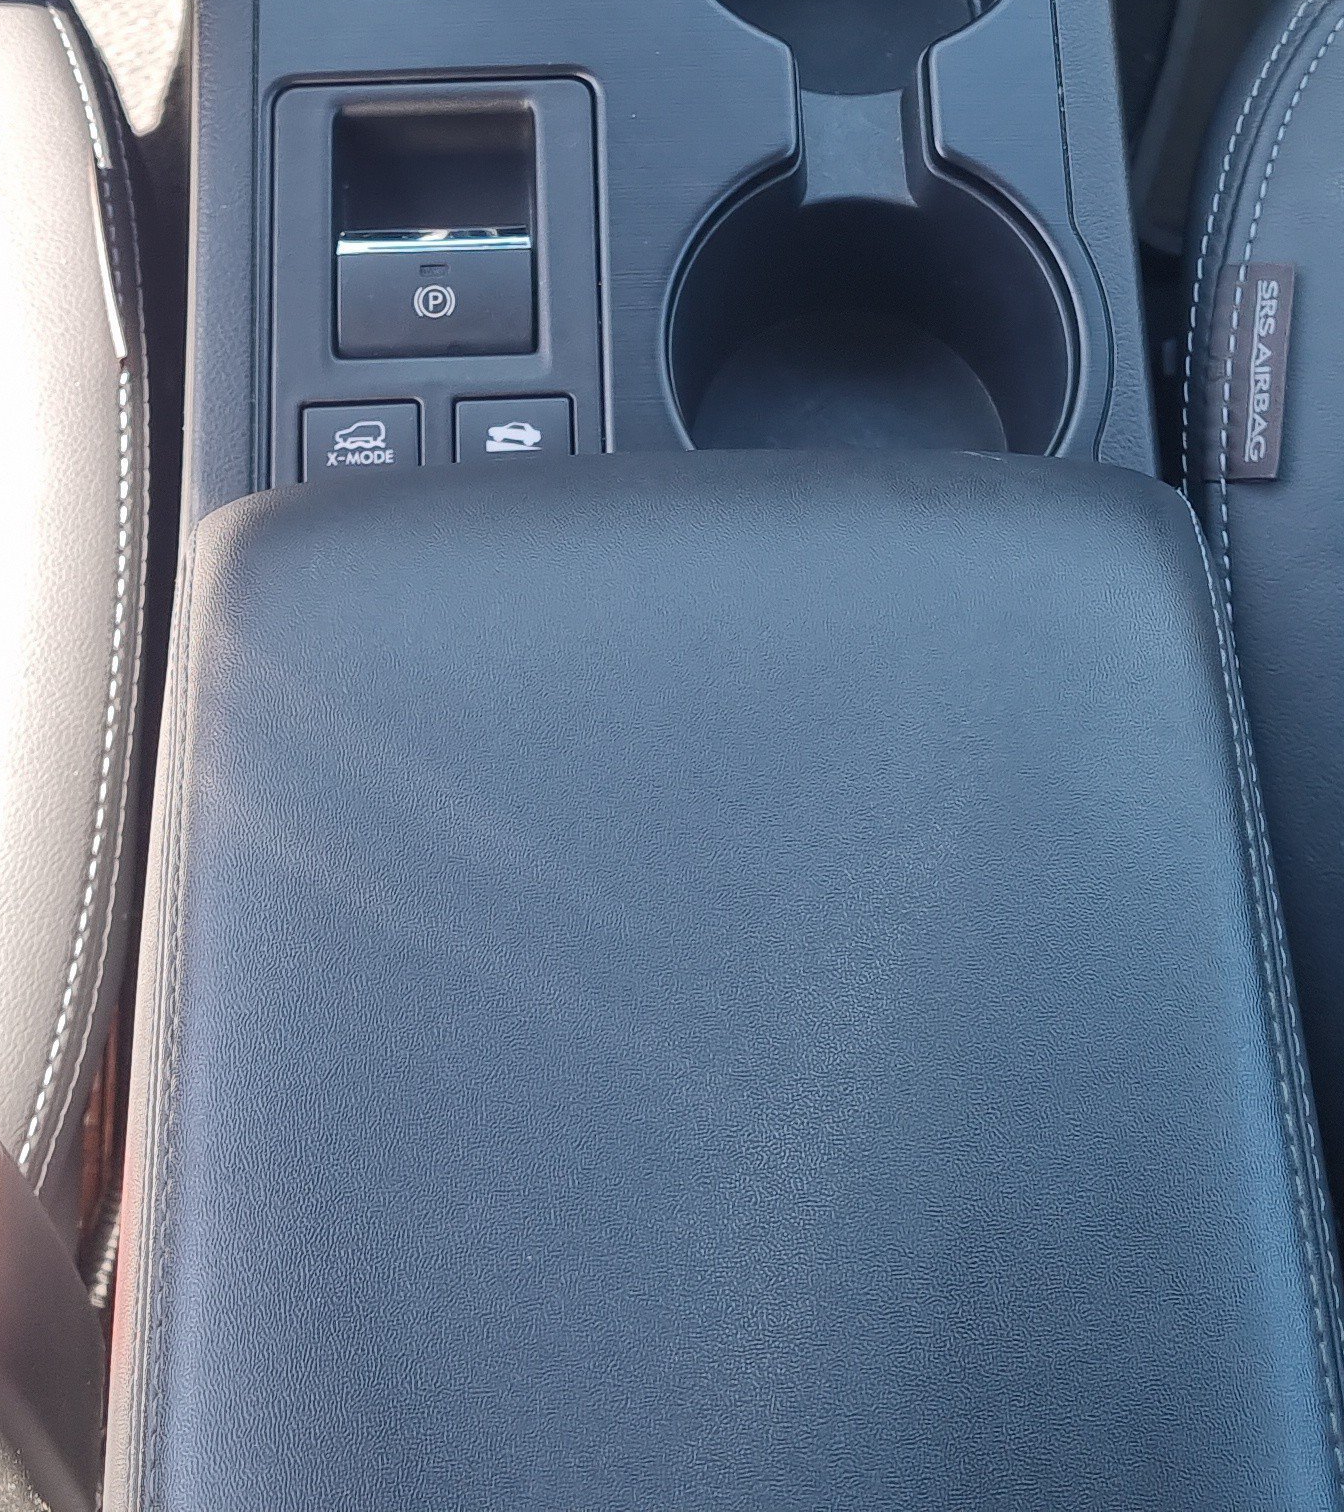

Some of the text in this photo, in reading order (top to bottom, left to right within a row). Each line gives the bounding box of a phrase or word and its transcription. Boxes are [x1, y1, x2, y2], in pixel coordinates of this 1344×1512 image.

[429, 291, 444, 312] P
[1248, 279, 1279, 463] SRS AIRBAG
[327, 449, 395, 467] X-MODE
